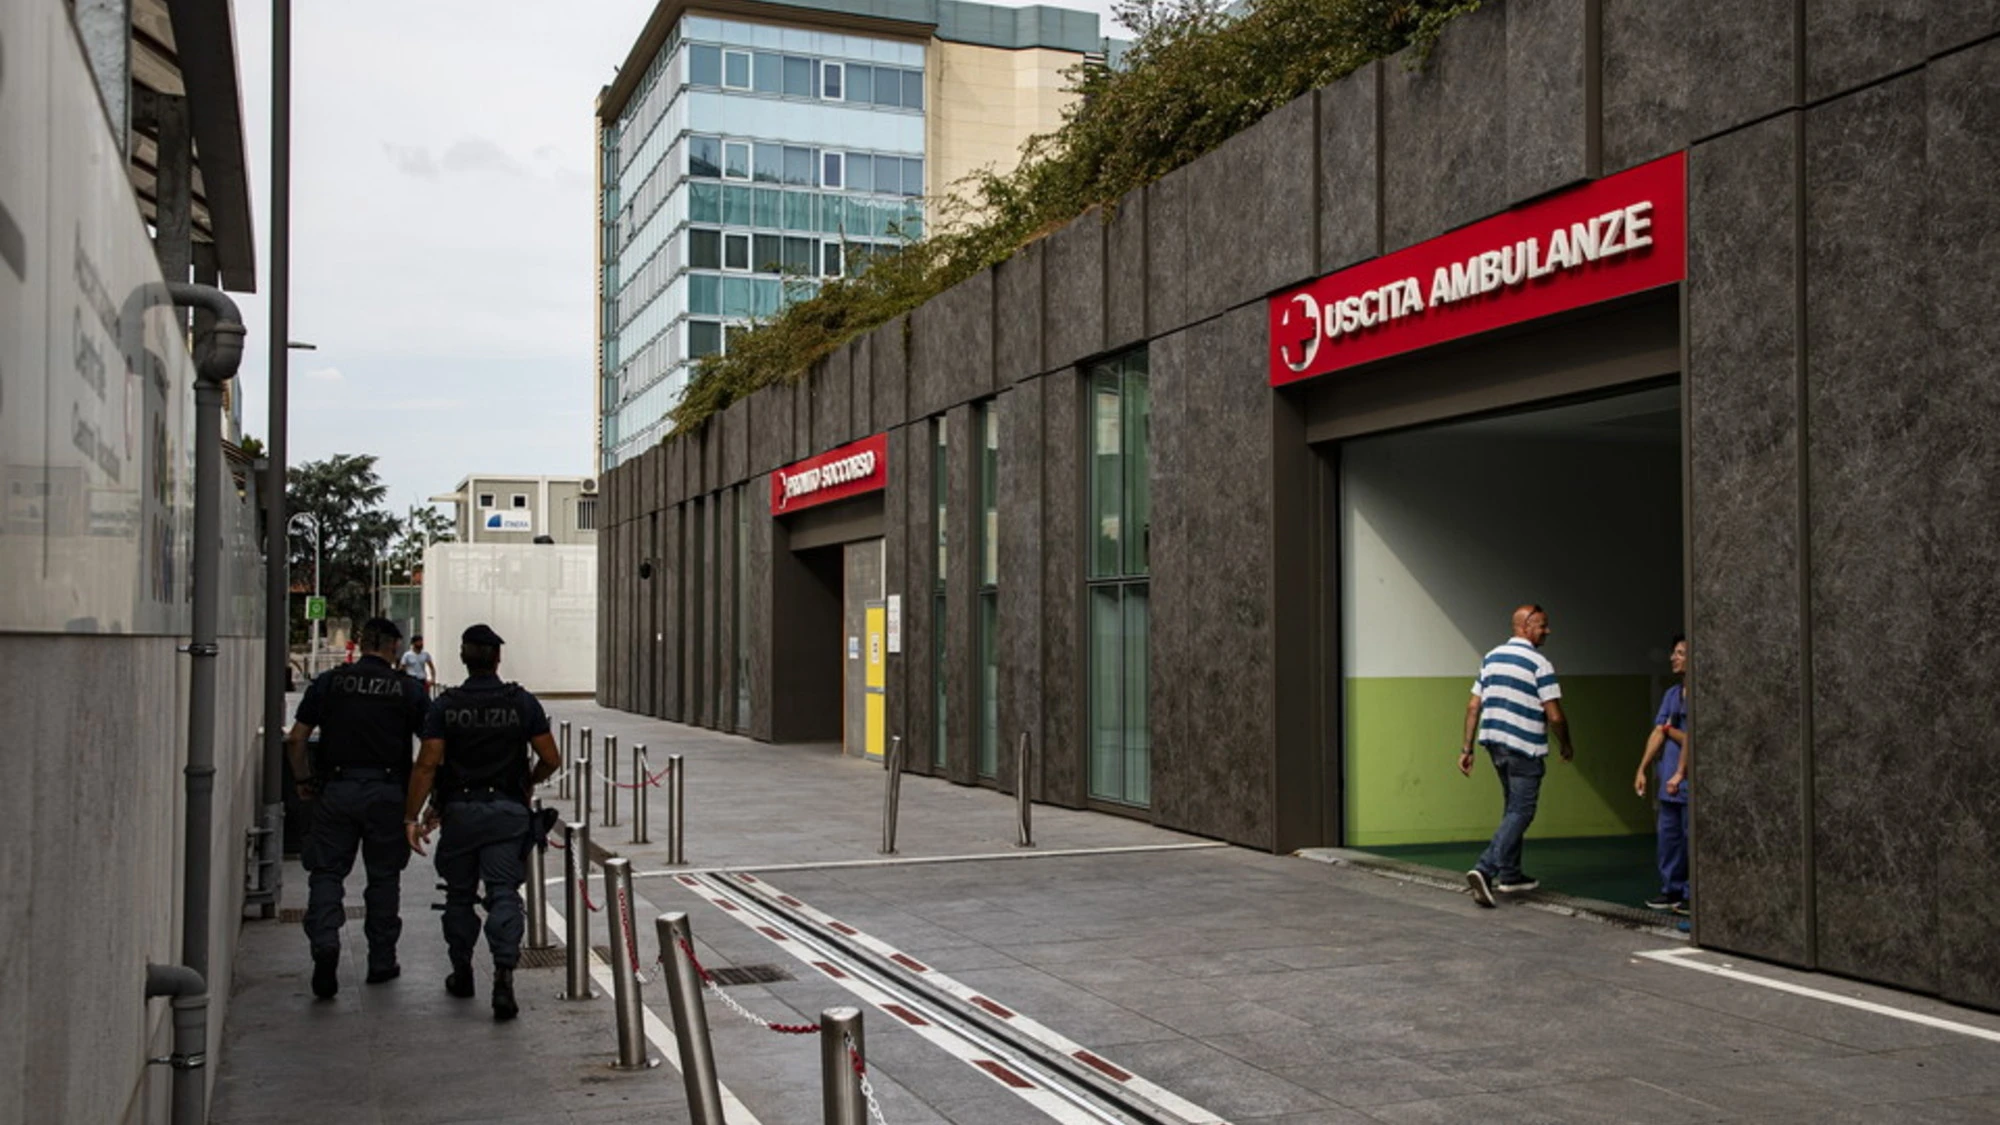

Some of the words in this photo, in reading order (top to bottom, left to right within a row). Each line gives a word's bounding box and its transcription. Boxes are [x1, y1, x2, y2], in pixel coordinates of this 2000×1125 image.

[1324, 277, 1424, 338] USCITA
[1429, 201, 1654, 307] AMBULANZE
[822, 450, 876, 488] SOCCORSO
[332, 674, 403, 696] POLIZIA
[445, 708, 520, 728] POLIZIA
